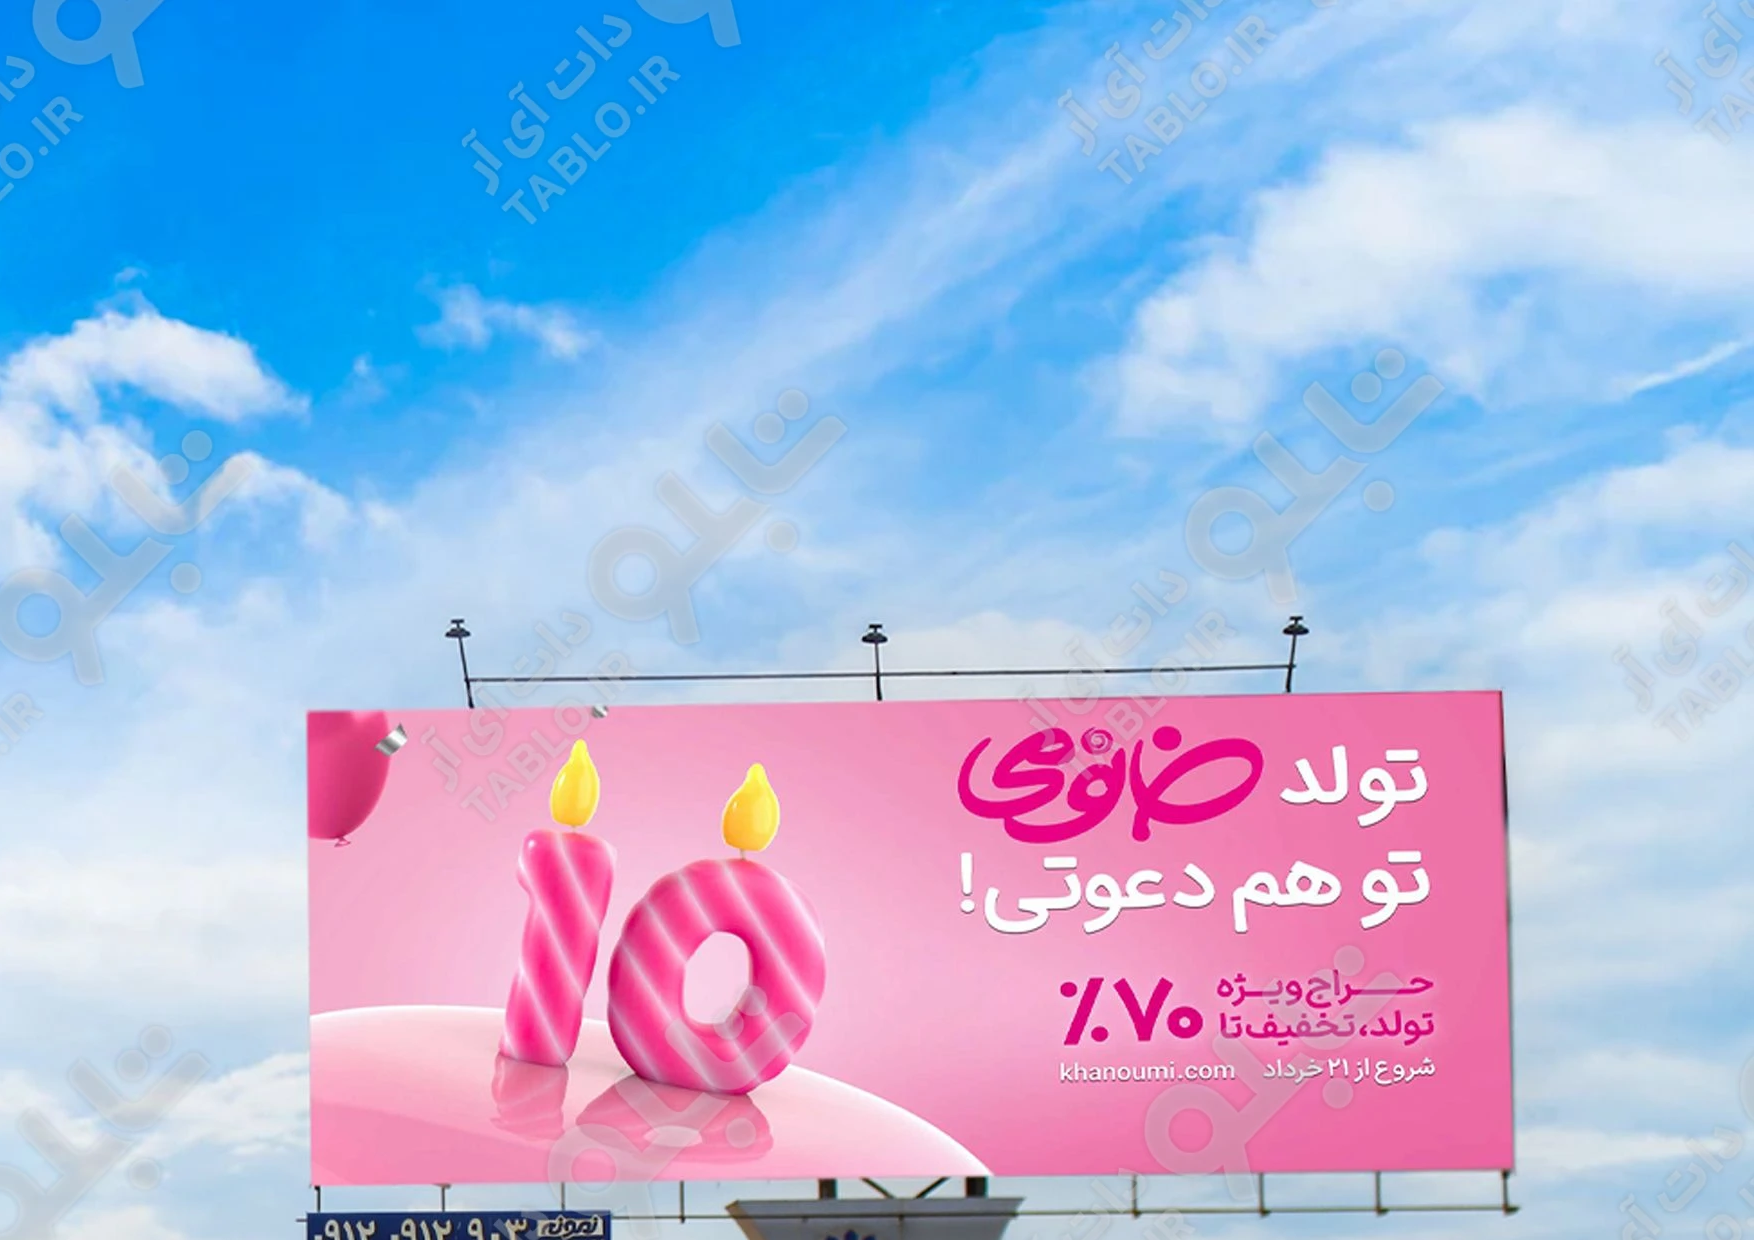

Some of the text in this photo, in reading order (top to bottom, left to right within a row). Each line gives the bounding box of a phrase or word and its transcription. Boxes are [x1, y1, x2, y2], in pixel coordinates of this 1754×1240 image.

[1280, 745, 1429, 827] تولد
[959, 851, 1430, 934] تو هم دعوتی!
[1216, 971, 1303, 1005] ویژه
[1219, 1011, 1243, 1040] تا
[1247, 1012, 1355, 1047] تخفیف
[1059, 1060, 1236, 1083] khanoumi.com
[1262, 1056, 1325, 1085] خرداد
[1353, 1059, 1371, 1085] از
[1375, 1056, 1436, 1087] شروع
